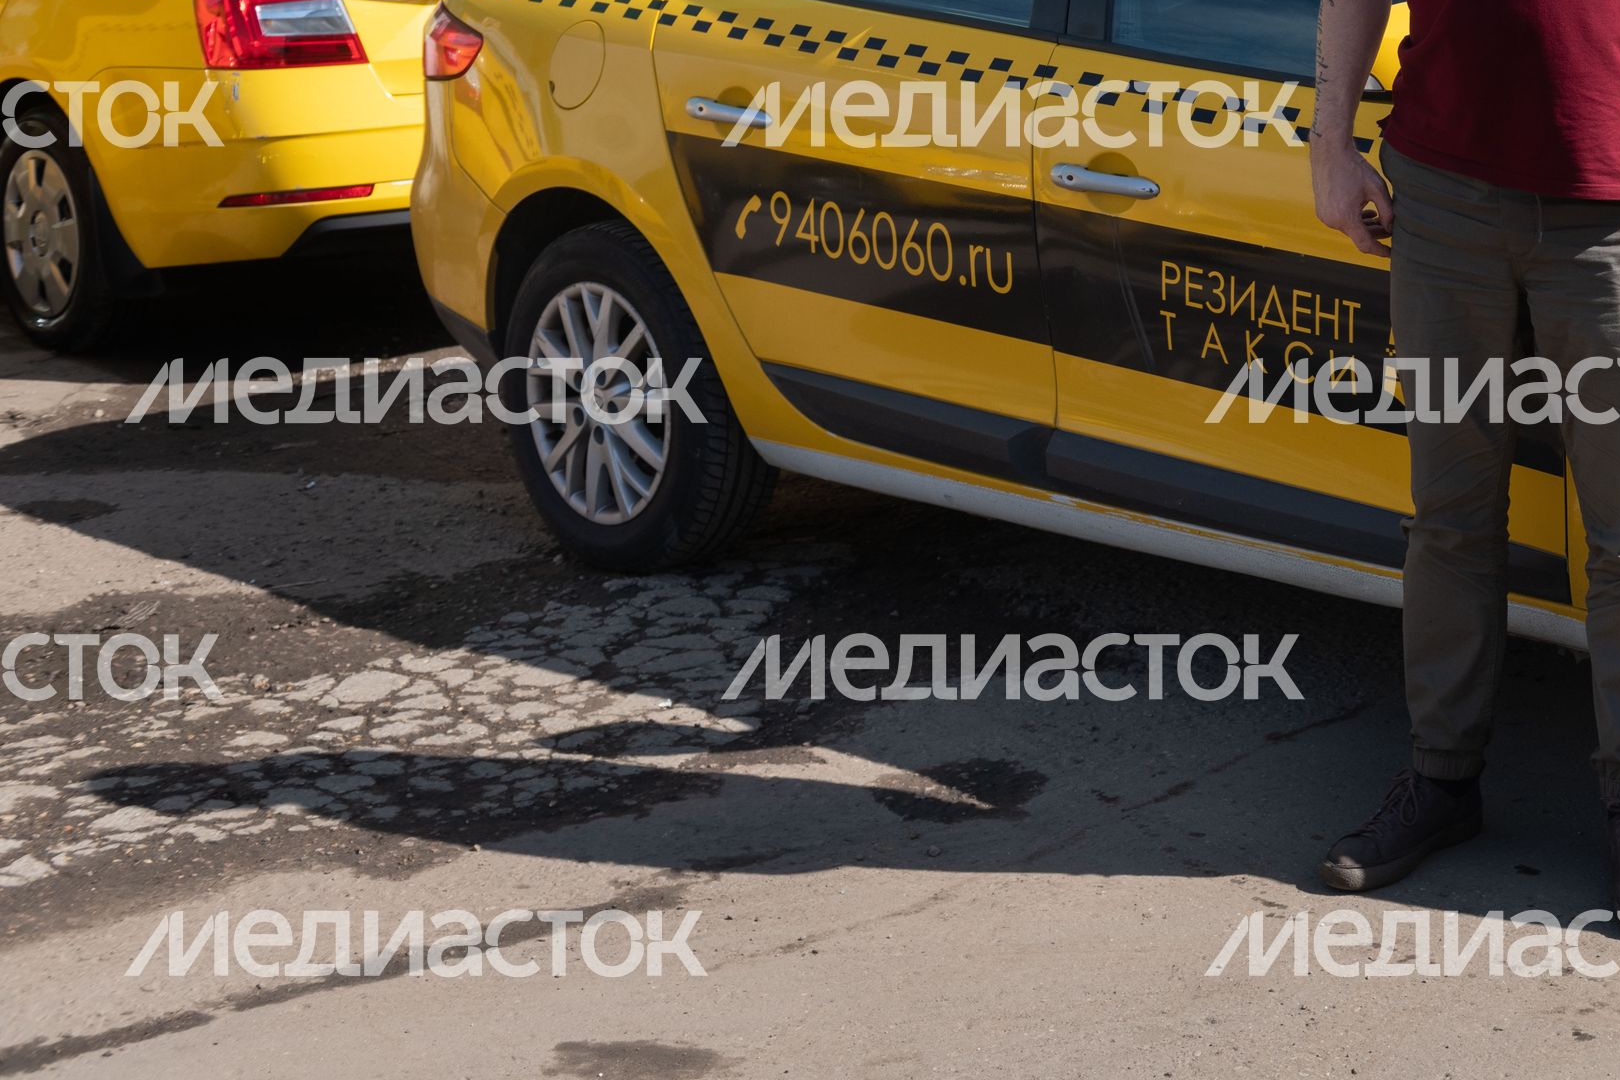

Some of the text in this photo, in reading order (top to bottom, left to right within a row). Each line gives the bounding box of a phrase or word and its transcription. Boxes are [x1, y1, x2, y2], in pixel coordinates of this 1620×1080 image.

[769, 190, 1013, 294] 9406060.ru
[1161, 260, 1361, 344] РЕЗИДЕНТ
[1159, 310, 1358, 396] ТАКСИ
